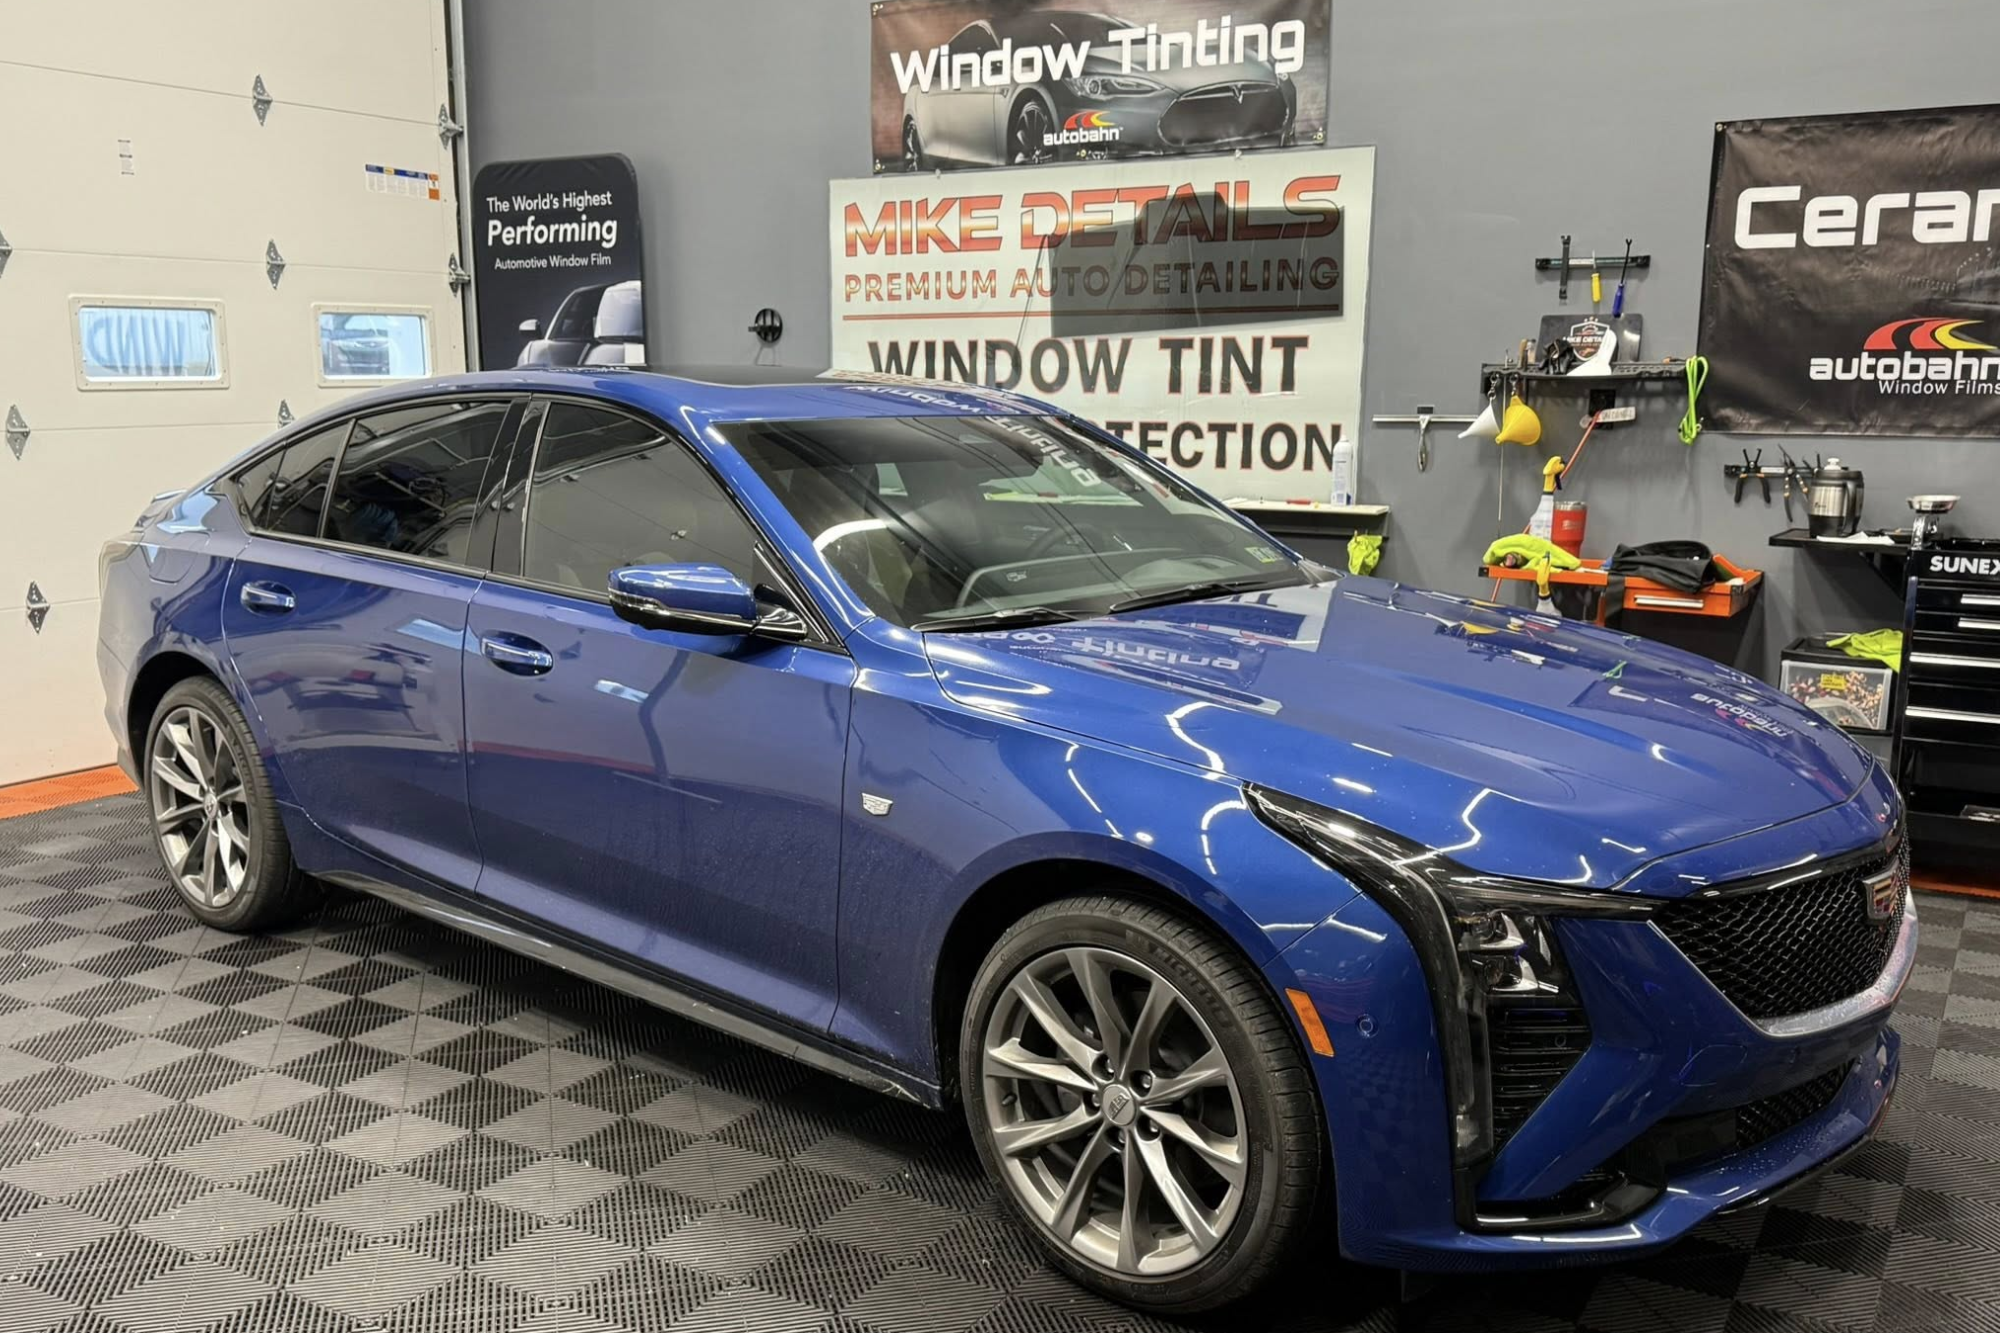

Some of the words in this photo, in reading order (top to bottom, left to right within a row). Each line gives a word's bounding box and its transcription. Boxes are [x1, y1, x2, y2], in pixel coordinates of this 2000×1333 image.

[889, 37, 1091, 94] Window
[1108, 15, 1305, 75] Tinting
[1043, 127, 1120, 146] autobahn
[486, 196, 510, 213] The
[512, 193, 559, 211] World's
[562, 190, 613, 212] Highest
[844, 194, 1003, 257] MIKE
[1020, 175, 1341, 249] DETAILS
[487, 213, 618, 249] Performing
[494, 256, 548, 270] Automotive
[549, 253, 589, 267] Window
[590, 252, 612, 266] Film
[844, 268, 998, 303] PREMIUM
[1010, 264, 1109, 299] AUTO
[1123, 256, 1341, 296] DETAILING
[867, 336, 1133, 395] WINDOW
[1158, 335, 1310, 395] TINT
[1809, 350, 2000, 381] autobahn
[1878, 379, 1949, 395] Window
[1955, 379, 2000, 395] Films
